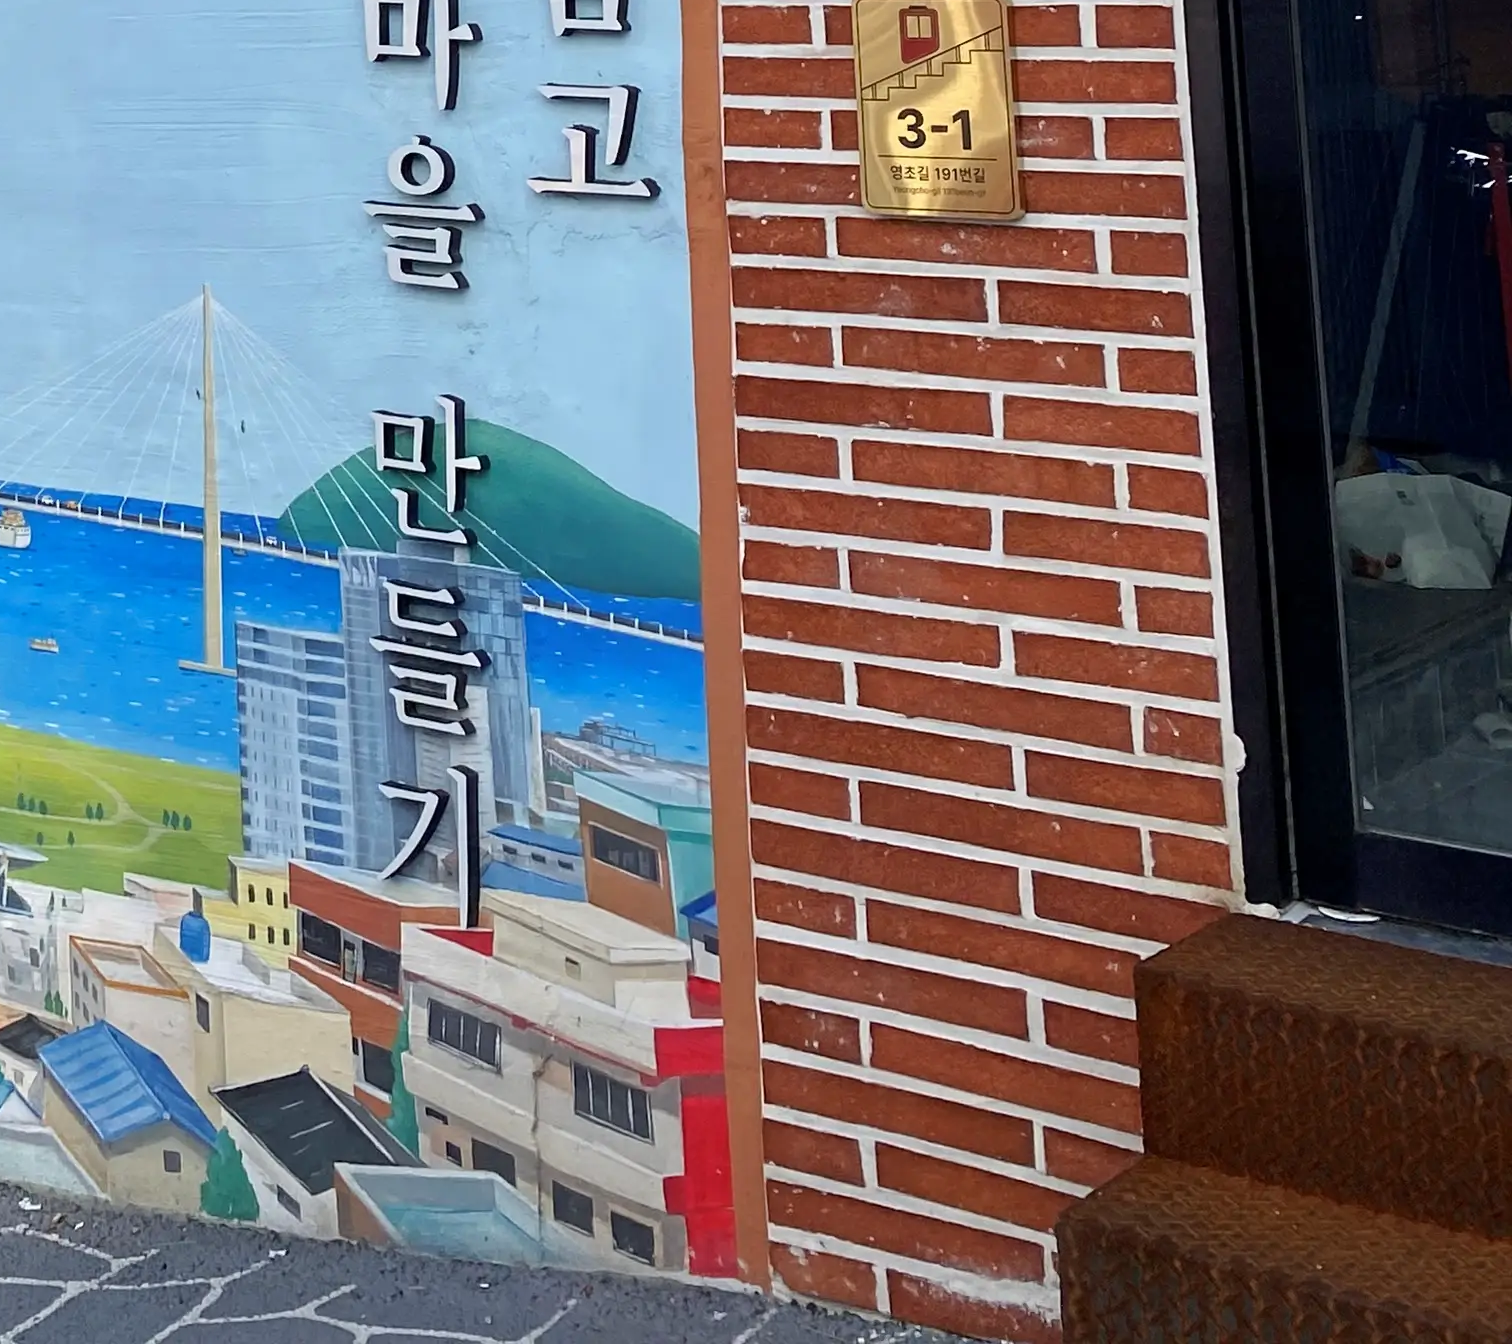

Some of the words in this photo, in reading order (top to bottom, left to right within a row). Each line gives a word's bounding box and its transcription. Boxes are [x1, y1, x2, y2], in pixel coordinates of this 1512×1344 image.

[896, 108, 973, 151] 3-1
[890, 164, 930, 182] 영초길
[934, 166, 987, 184] 191번길
[369, 393, 492, 930] 만들기
